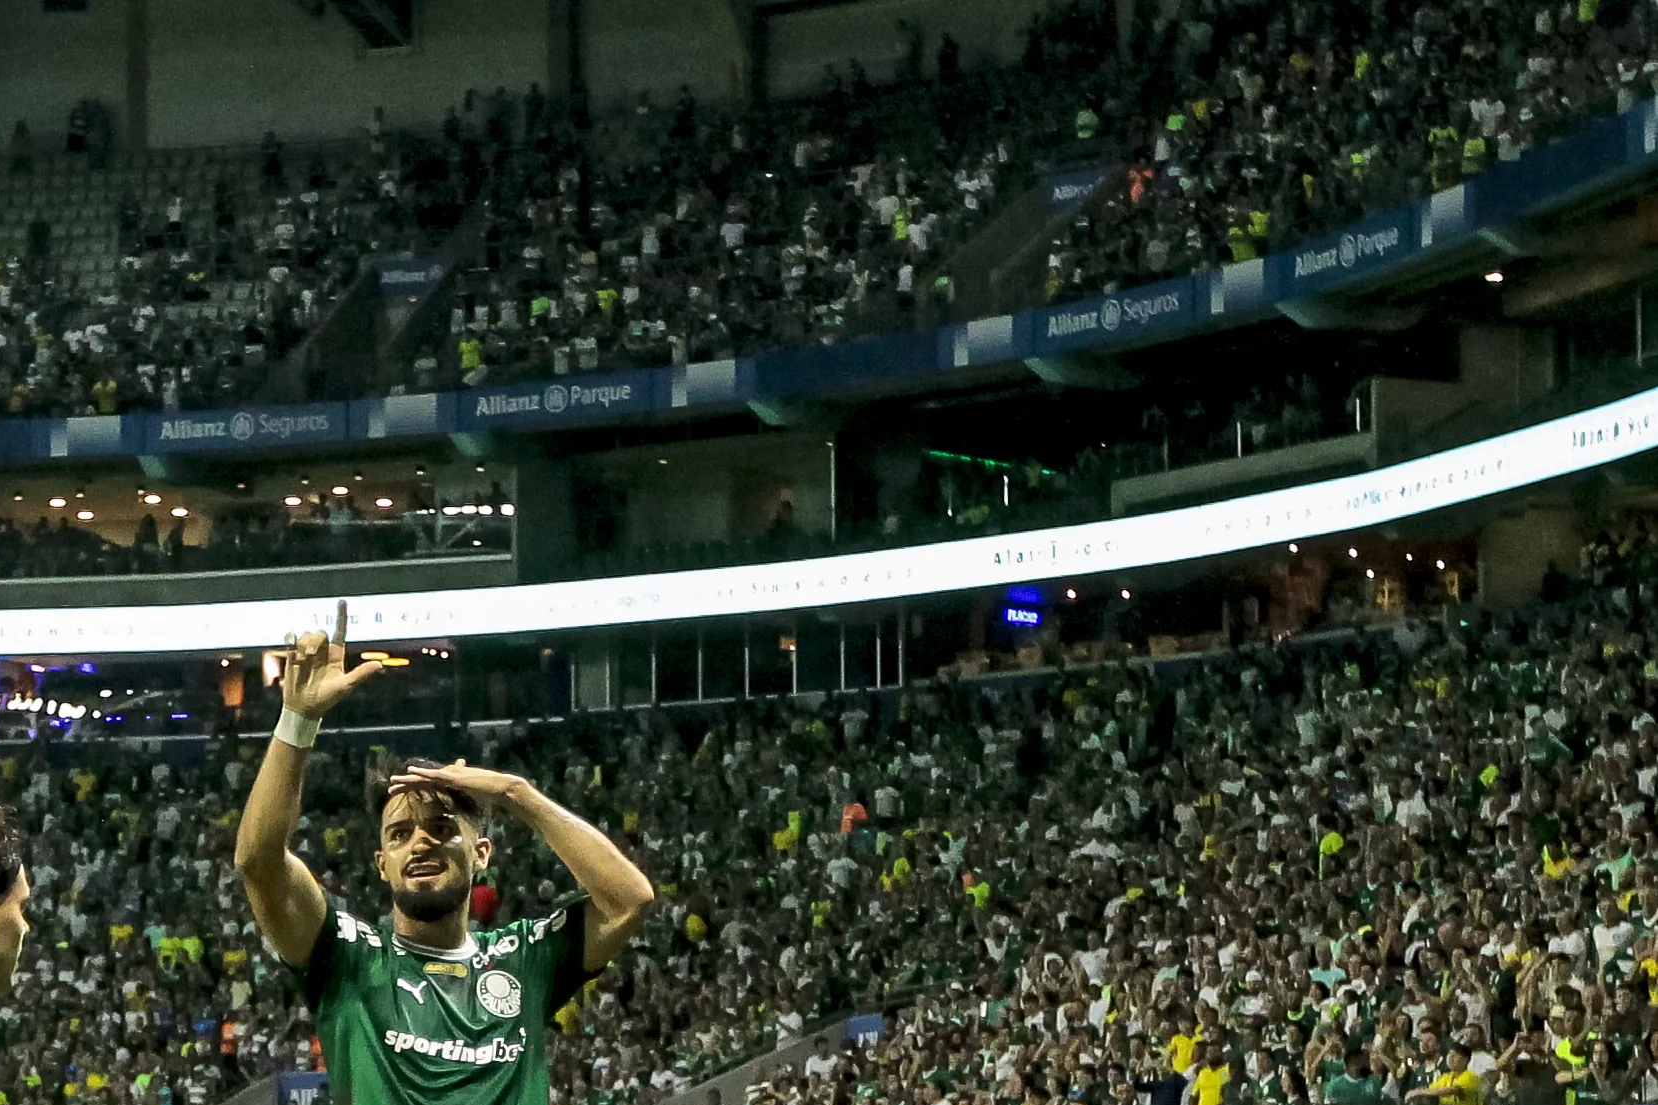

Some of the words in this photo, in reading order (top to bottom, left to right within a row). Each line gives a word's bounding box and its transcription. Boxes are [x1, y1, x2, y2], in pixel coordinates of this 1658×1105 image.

[1047, 311, 1099, 338] Allianz
[476, 394, 541, 417] Allianz
[570, 385, 632, 408] Parque
[160, 419, 227, 441] Allianz
[259, 413, 330, 439] Seguros
